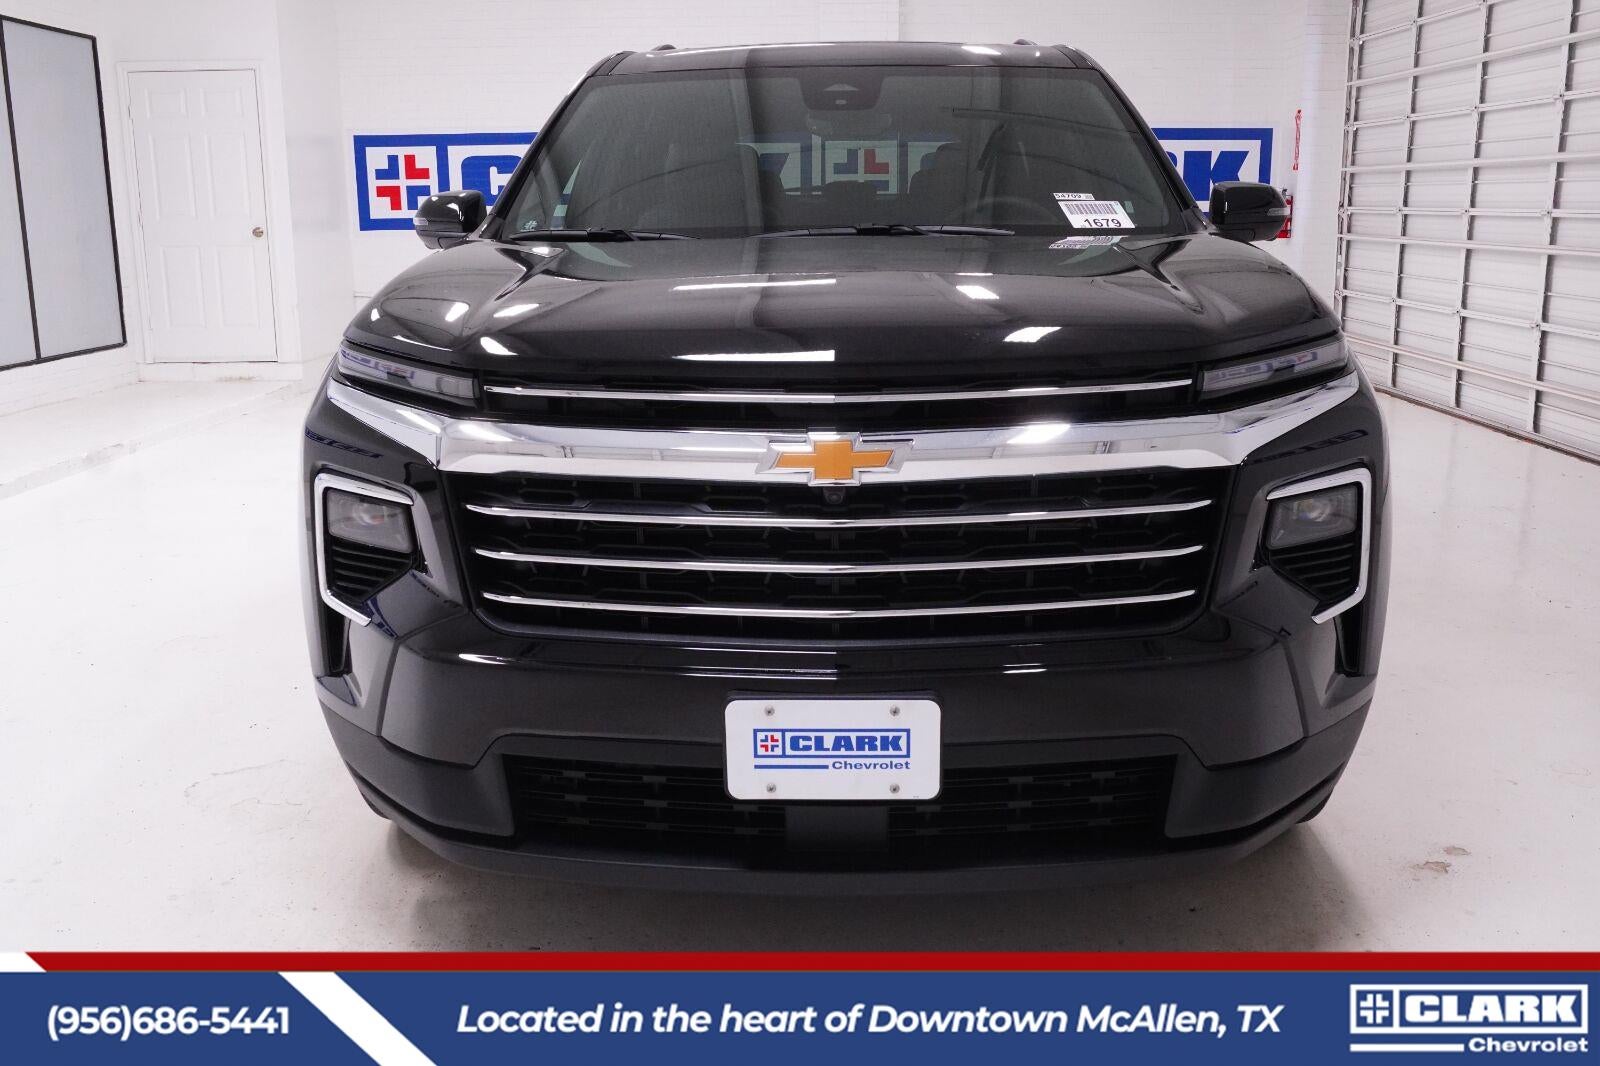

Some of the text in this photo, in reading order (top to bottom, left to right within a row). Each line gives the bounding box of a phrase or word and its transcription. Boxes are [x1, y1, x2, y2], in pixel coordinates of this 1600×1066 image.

[1084, 218, 1122, 228] 1679
[789, 735, 903, 752] CLARK
[831, 760, 911, 771] Chevrolet
